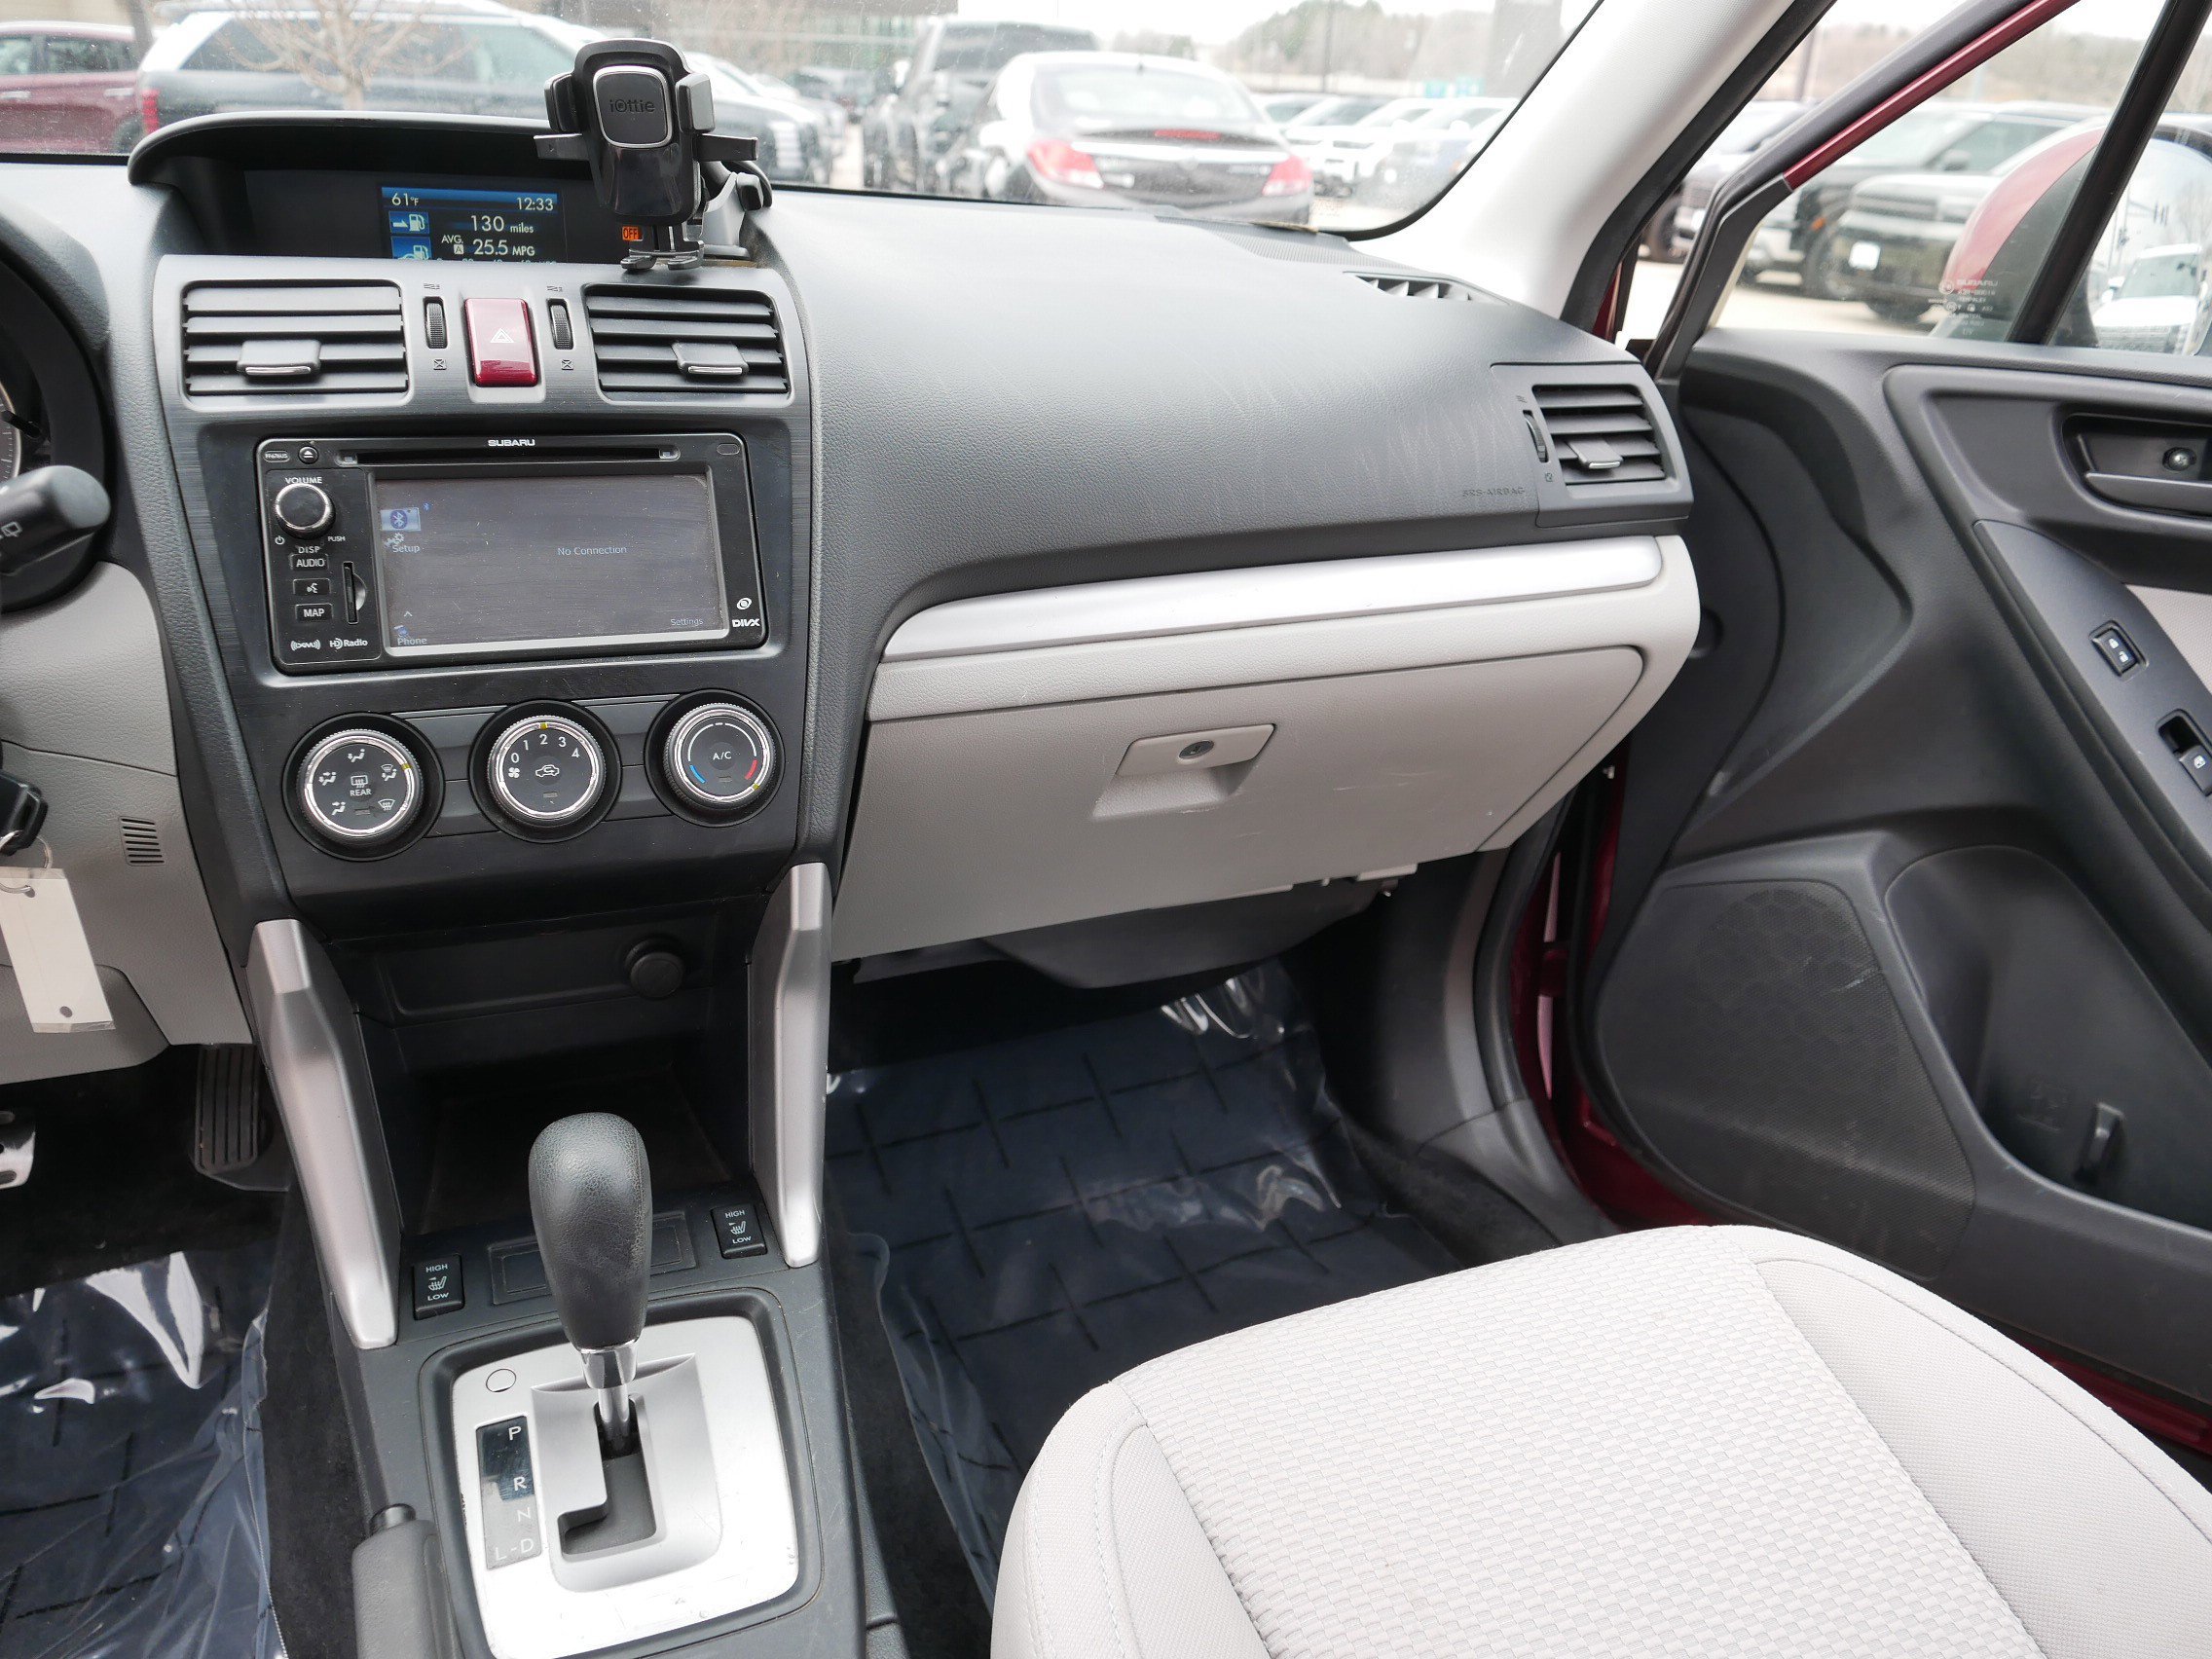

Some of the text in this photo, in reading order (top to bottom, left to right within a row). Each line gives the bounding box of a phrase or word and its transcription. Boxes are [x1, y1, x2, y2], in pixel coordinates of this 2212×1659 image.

[609, 98, 655, 113] iOttie
[516, 197, 554, 211] 12:33
[470, 215, 534, 234] 130 miles
[623, 227, 638, 240] OFF
[441, 235, 463, 244] AVG.
[472, 239, 535, 257] 25.5 MPG
[488, 438, 535, 447] SUBARU
[298, 545, 320, 554] DISP
[392, 545, 421, 554] Setup
[557, 545, 628, 556] No Connection
[296, 558, 325, 568] AUDIO
[303, 608, 325, 618] MAP
[670, 617, 704, 627] Settings
[397, 637, 427, 645] Phone
[510, 733, 580, 763] 0 1 2 3 4
[713, 751, 732, 760] A/C
[350, 789, 372, 797] REAR
[724, 1208, 746, 1219] HIGH
[732, 1235, 752, 1245] LOW
[425, 1263, 448, 1273] HIGH
[426, 1291, 450, 1302] LOW
[508, 1425, 522, 1441] P
[513, 1476, 527, 1492] R
[517, 1506, 532, 1523] N
